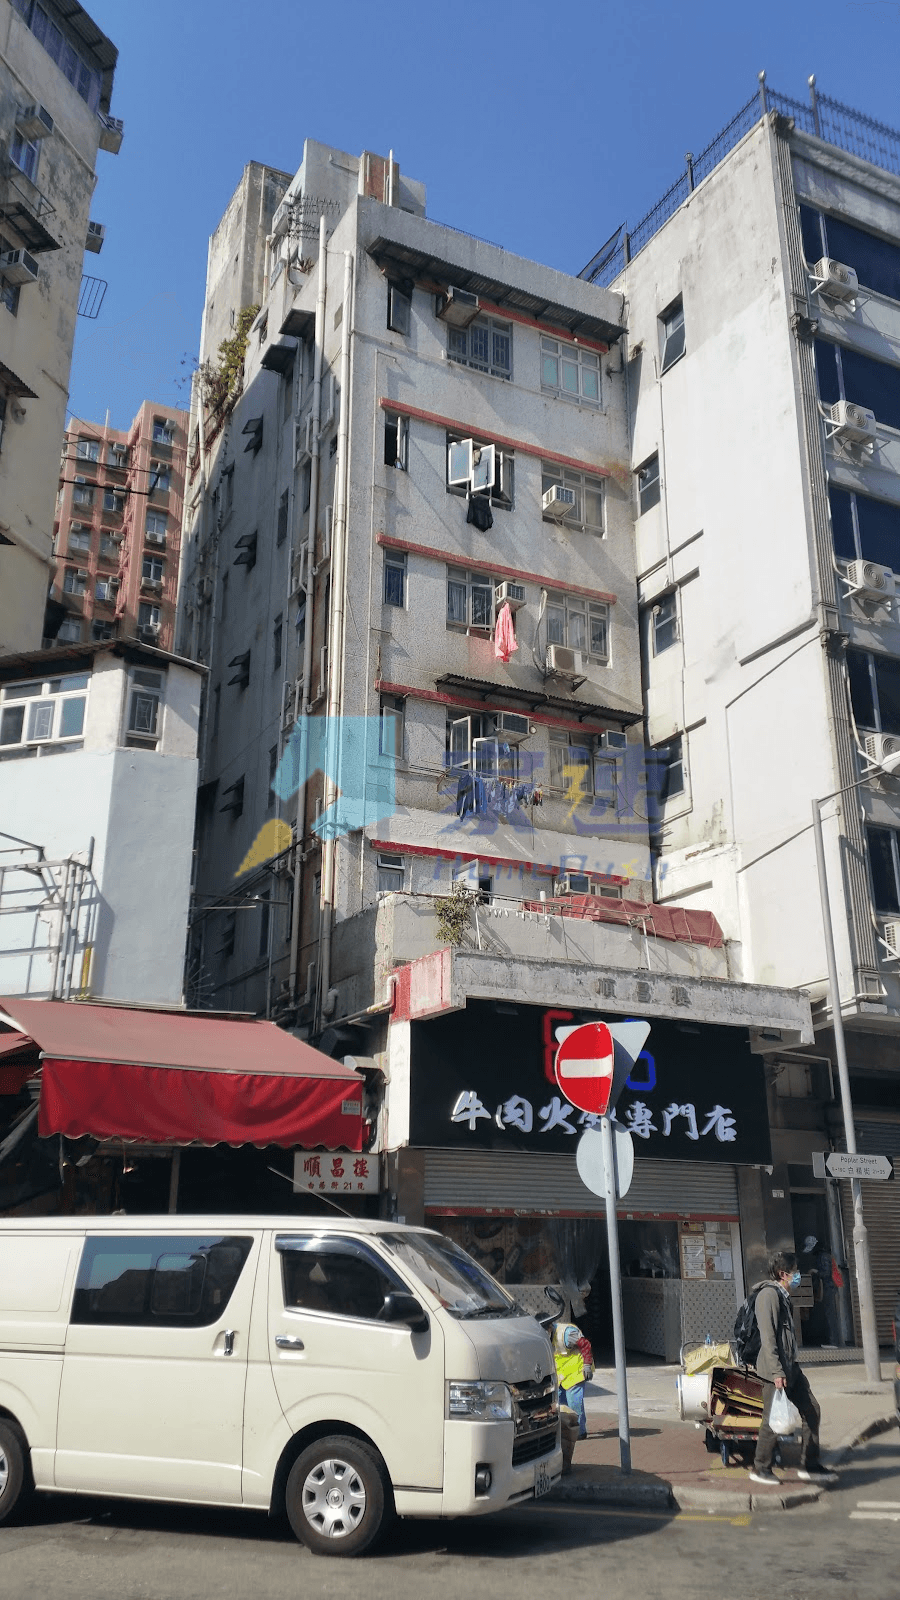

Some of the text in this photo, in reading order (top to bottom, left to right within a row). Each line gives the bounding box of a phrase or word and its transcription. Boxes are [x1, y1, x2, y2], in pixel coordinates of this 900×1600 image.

[304, 1155, 369, 1178] 順昌樓
[841, 1156, 877, 1165] Poplar Street
